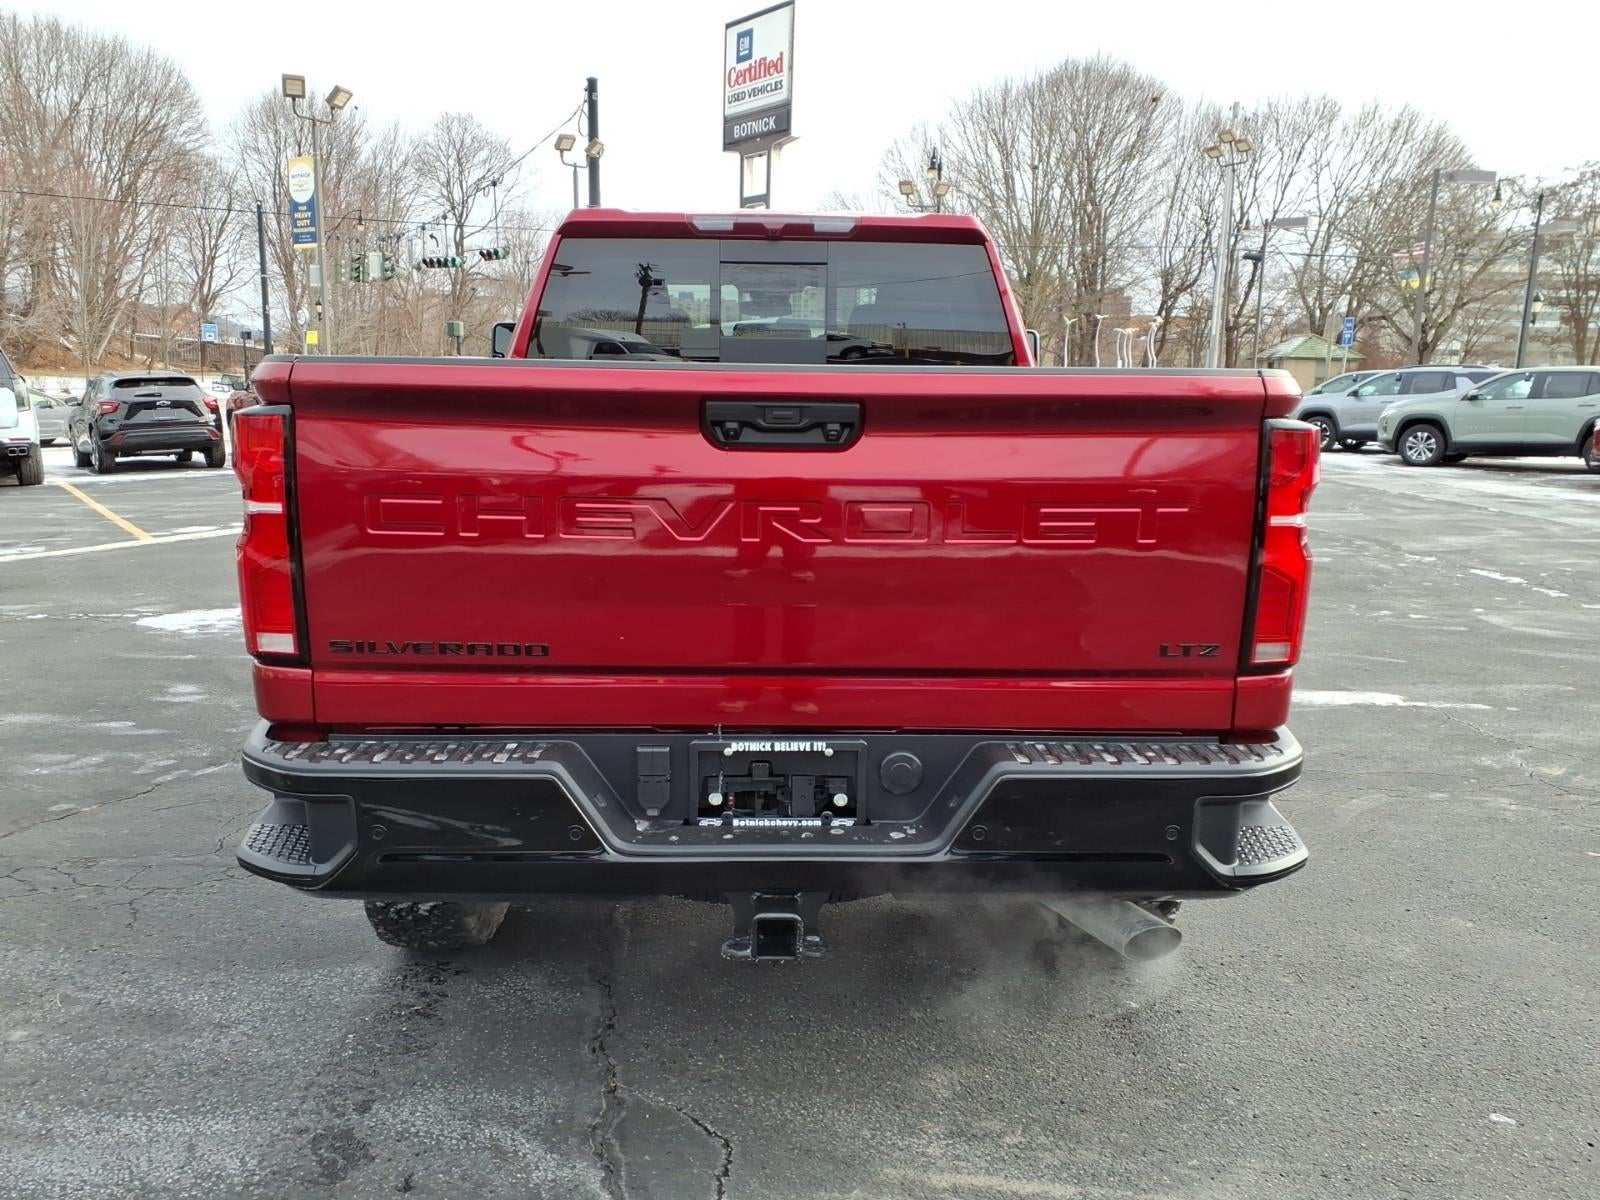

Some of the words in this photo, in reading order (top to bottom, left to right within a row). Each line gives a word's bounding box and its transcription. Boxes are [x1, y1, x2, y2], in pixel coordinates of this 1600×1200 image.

[739, 36, 750, 51] GM
[728, 51, 784, 88] Certified
[727, 91, 746, 105] USED
[747, 79, 784, 99] VEHICLES
[733, 116, 776, 139] BOTNICK
[294, 211, 312, 219] HEAVY
[296, 219, 311, 227] DUTY
[364, 493, 1191, 546] CHEVROLET
[328, 639, 550, 657] SILVERADO
[1159, 643, 1221, 658] LTZ
[731, 742, 772, 752] BOTNICK
[774, 742, 811, 752] BELIEVE
[813, 742, 827, 752] IT!
